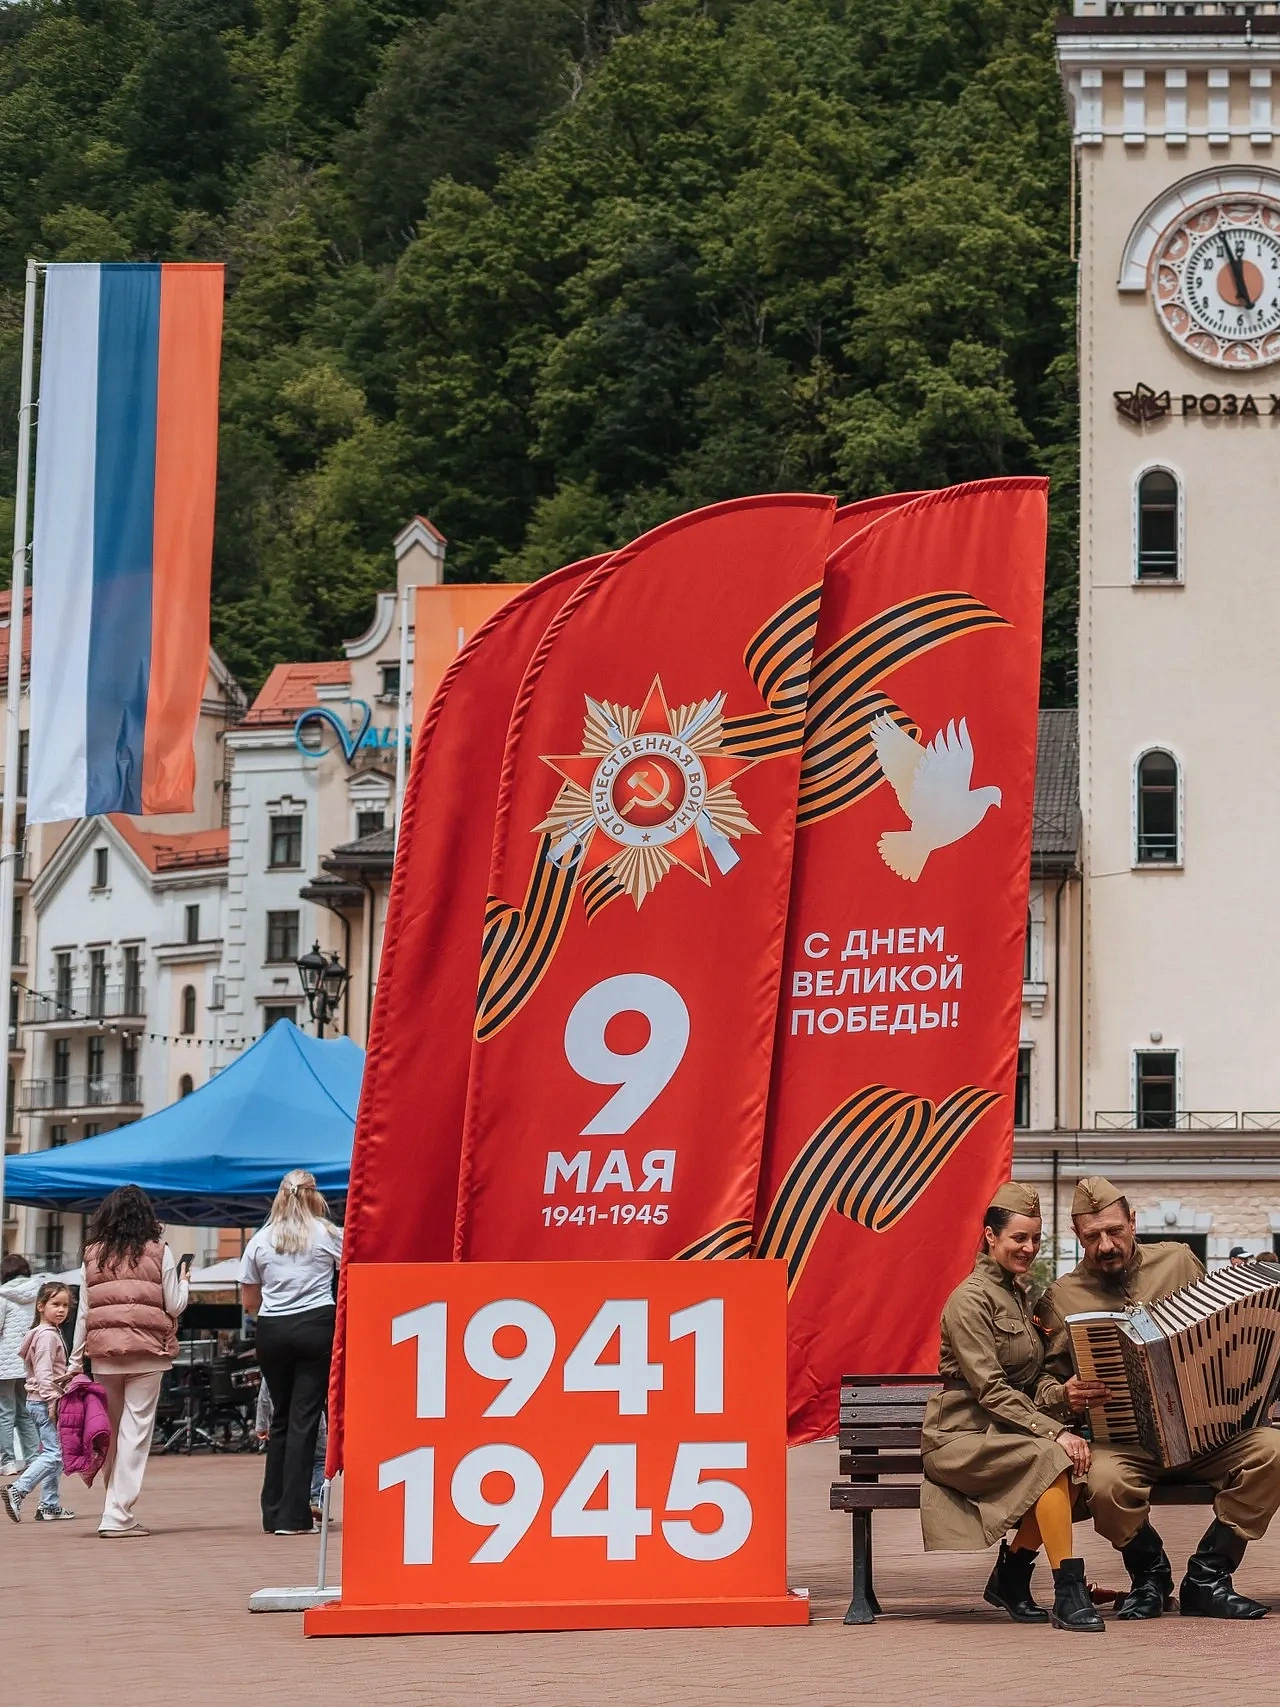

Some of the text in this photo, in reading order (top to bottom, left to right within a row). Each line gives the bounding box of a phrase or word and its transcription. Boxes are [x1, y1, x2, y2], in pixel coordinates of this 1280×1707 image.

[1216, 245, 1224, 258] 11
[1235, 240, 1245, 253] 12
[1257, 244, 1262, 257] 1
[1203, 257, 1214, 270] 10
[1271, 257, 1278, 270] 2
[1196, 276, 1203, 289] 9
[1202, 296, 1209, 309] 8
[1271, 297, 1278, 308] 4
[1218, 309, 1225, 321] 7
[1237, 314, 1244, 327] 6
[1257, 309, 1263, 321] 5
[1181, 393, 1259, 416] РОЗА
[294, 698, 412, 765] VALS
[595, 737, 702, 836] ОТЕЧЕСТВЕННАЯ ВОЙНА
[804, 926, 945, 962] С ДНЕМ
[792, 954, 963, 997] ВЕЛИКОЙ
[791, 1002, 959, 1035] ПОБЕДЫ!
[564, 972, 691, 1136] 9
[543, 1149, 677, 1194] МАЯ
[541, 1204, 669, 1227] 1941-1945
[391, 1297, 724, 1419] 1941
[378, 1441, 753, 1566] 1945
